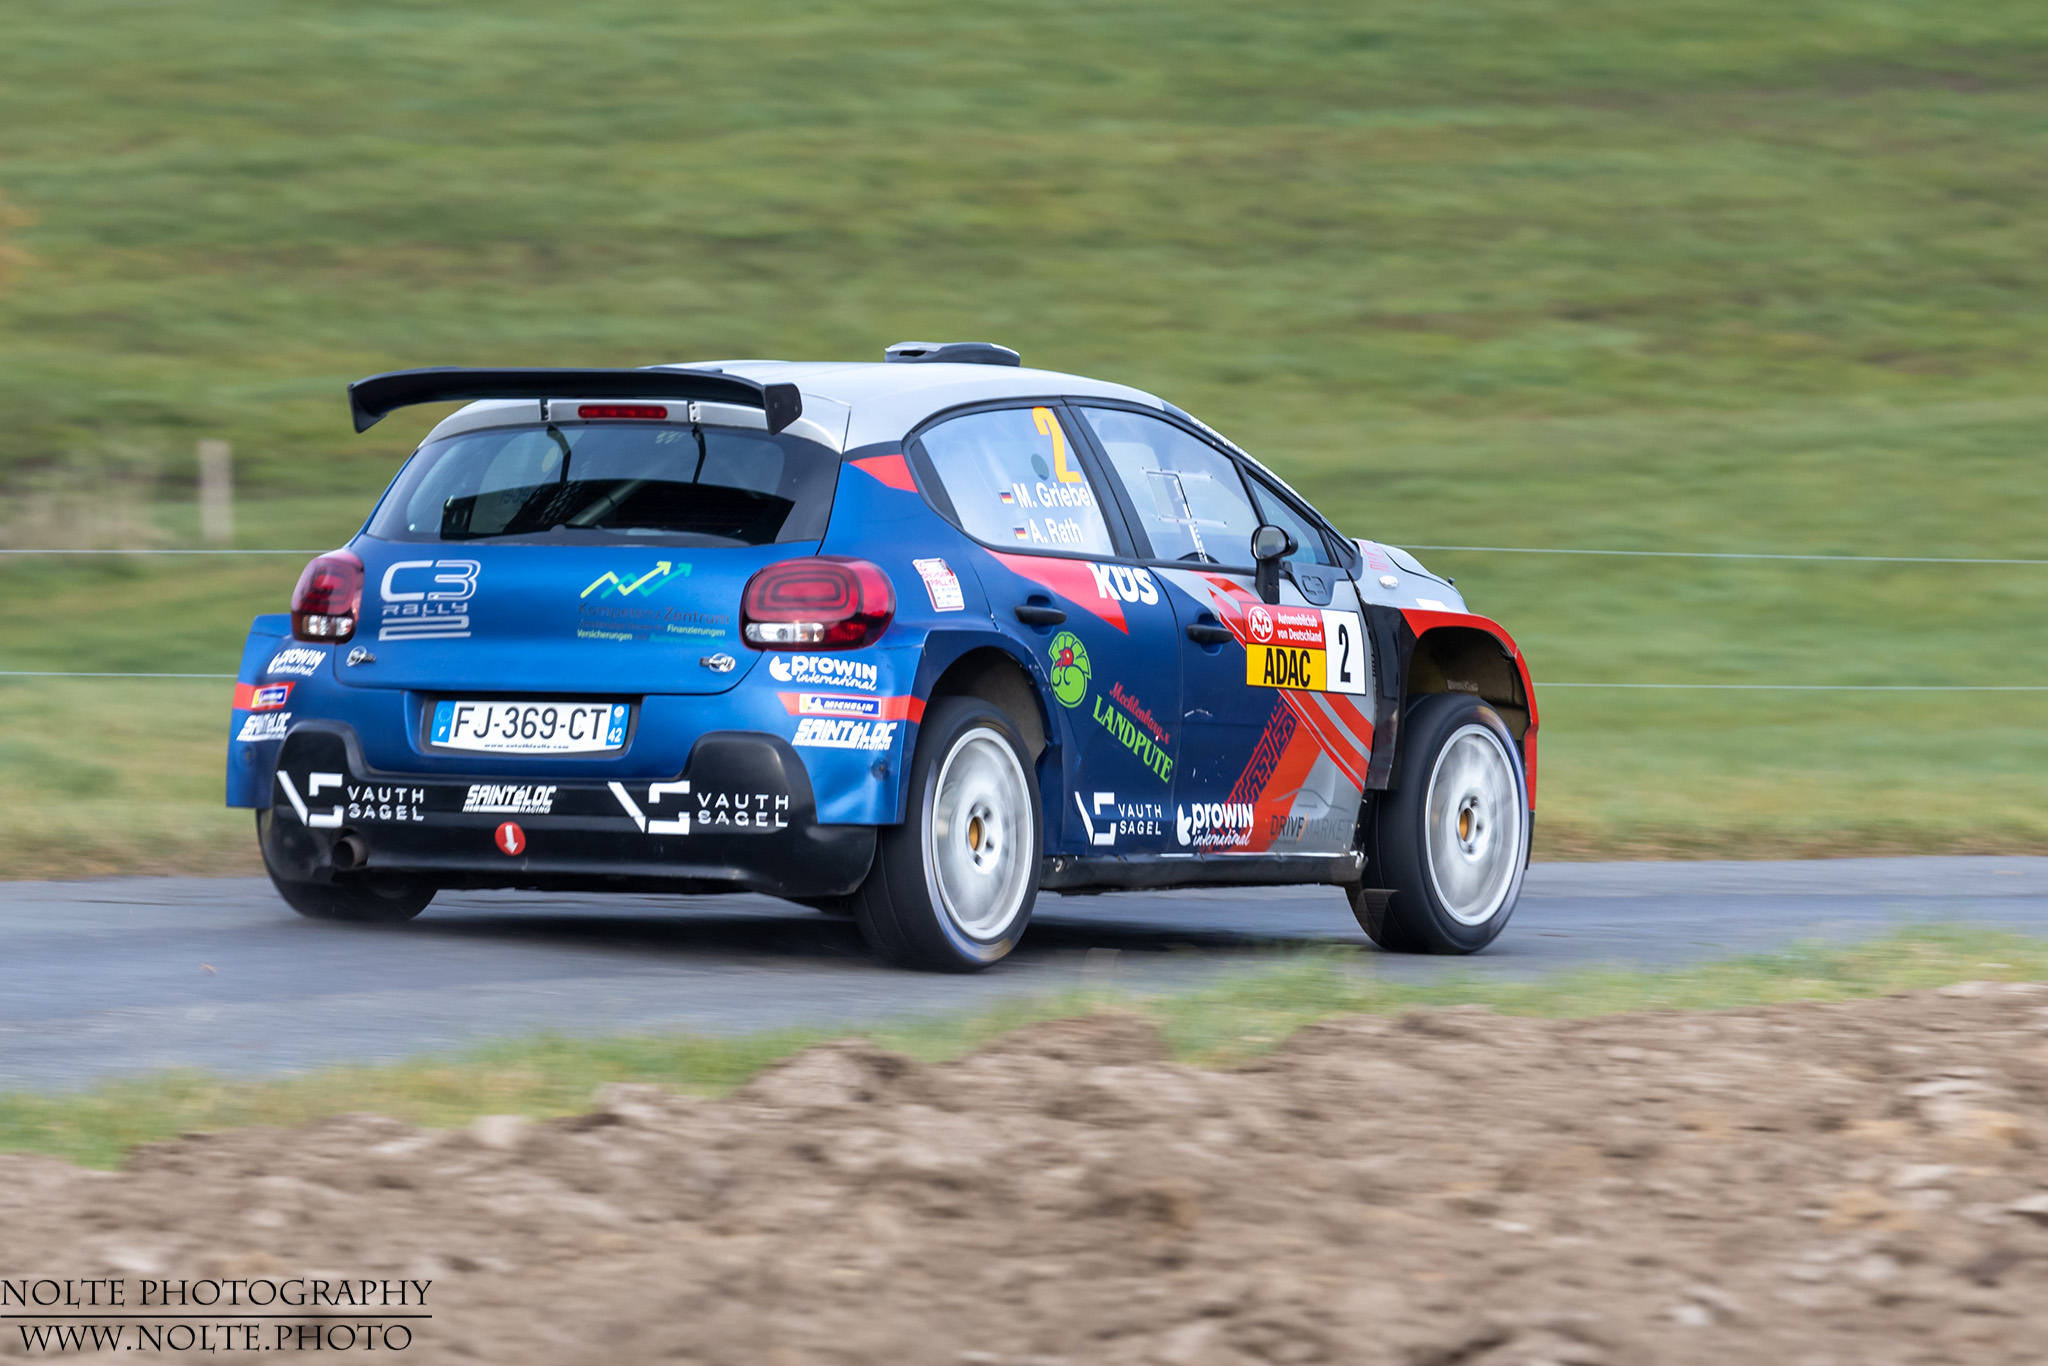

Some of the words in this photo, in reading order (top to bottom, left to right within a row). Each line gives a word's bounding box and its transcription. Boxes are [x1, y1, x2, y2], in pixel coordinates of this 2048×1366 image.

[1031, 407, 1082, 483] 2
[1012, 483, 1037, 508] M.
[1035, 482, 1095, 508] Griebel
[1029, 518, 1048, 544] A.
[1044, 518, 1083, 543] Rath
[380, 559, 481, 602] C3
[1086, 563, 1159, 605] KÜS
[1277, 612, 1318, 627] Automobilclub
[1277, 629, 1288, 639] von
[1288, 628, 1322, 643] Deutschland
[1338, 623, 1351, 683] 2
[1263, 647, 1311, 688] ADAC
[796, 671, 877, 691] international
[824, 700, 874, 712] MICHELIN
[453, 706, 607, 741] FJ-369-CT
[608, 727, 623, 743] 42
[1093, 694, 1173, 783] LANDPUTE
[347, 785, 424, 804] VAUTH
[697, 792, 789, 810] VAUTH
[348, 803, 424, 821] SAGEL
[697, 811, 788, 828] SAGEL
[1118, 803, 1162, 819] VAUTH
[1119, 820, 1162, 836] SAGEL
